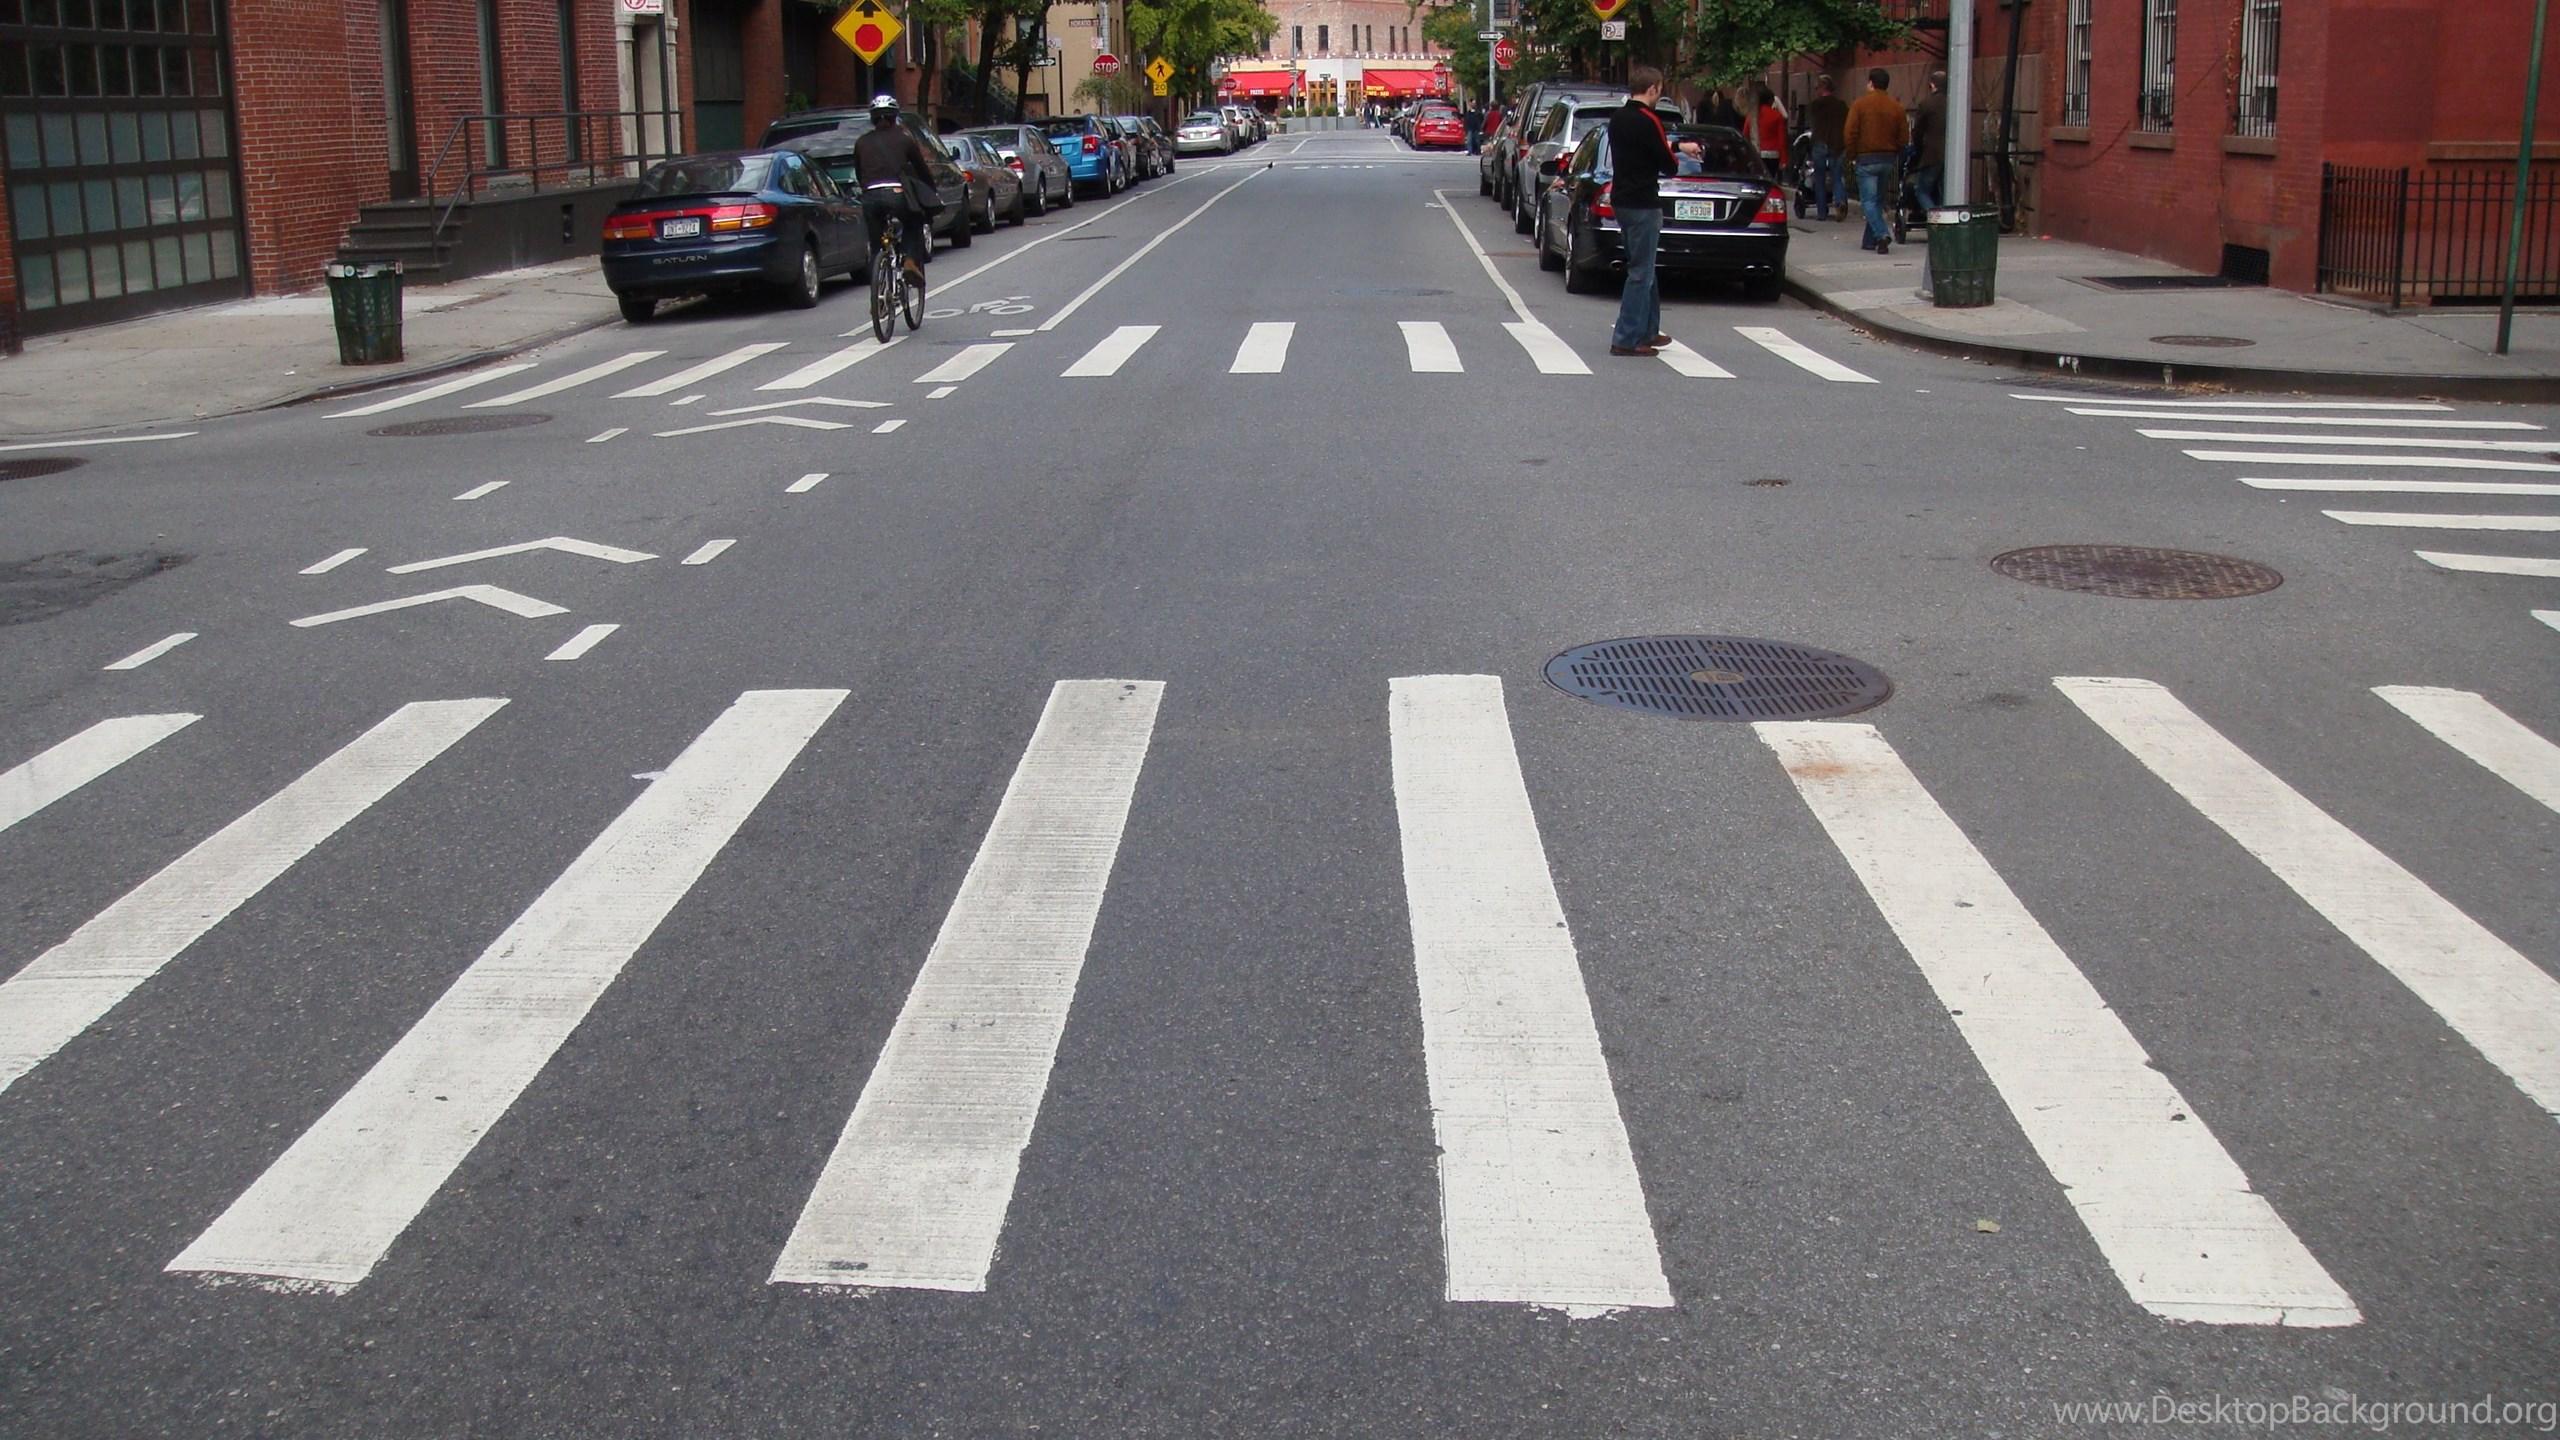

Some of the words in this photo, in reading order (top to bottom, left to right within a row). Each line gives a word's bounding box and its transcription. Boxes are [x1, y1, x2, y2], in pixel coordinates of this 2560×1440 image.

[1094, 62, 1118, 73] STOP
[1155, 83, 1166, 91] 20
[653, 255, 708, 264] SATURN
